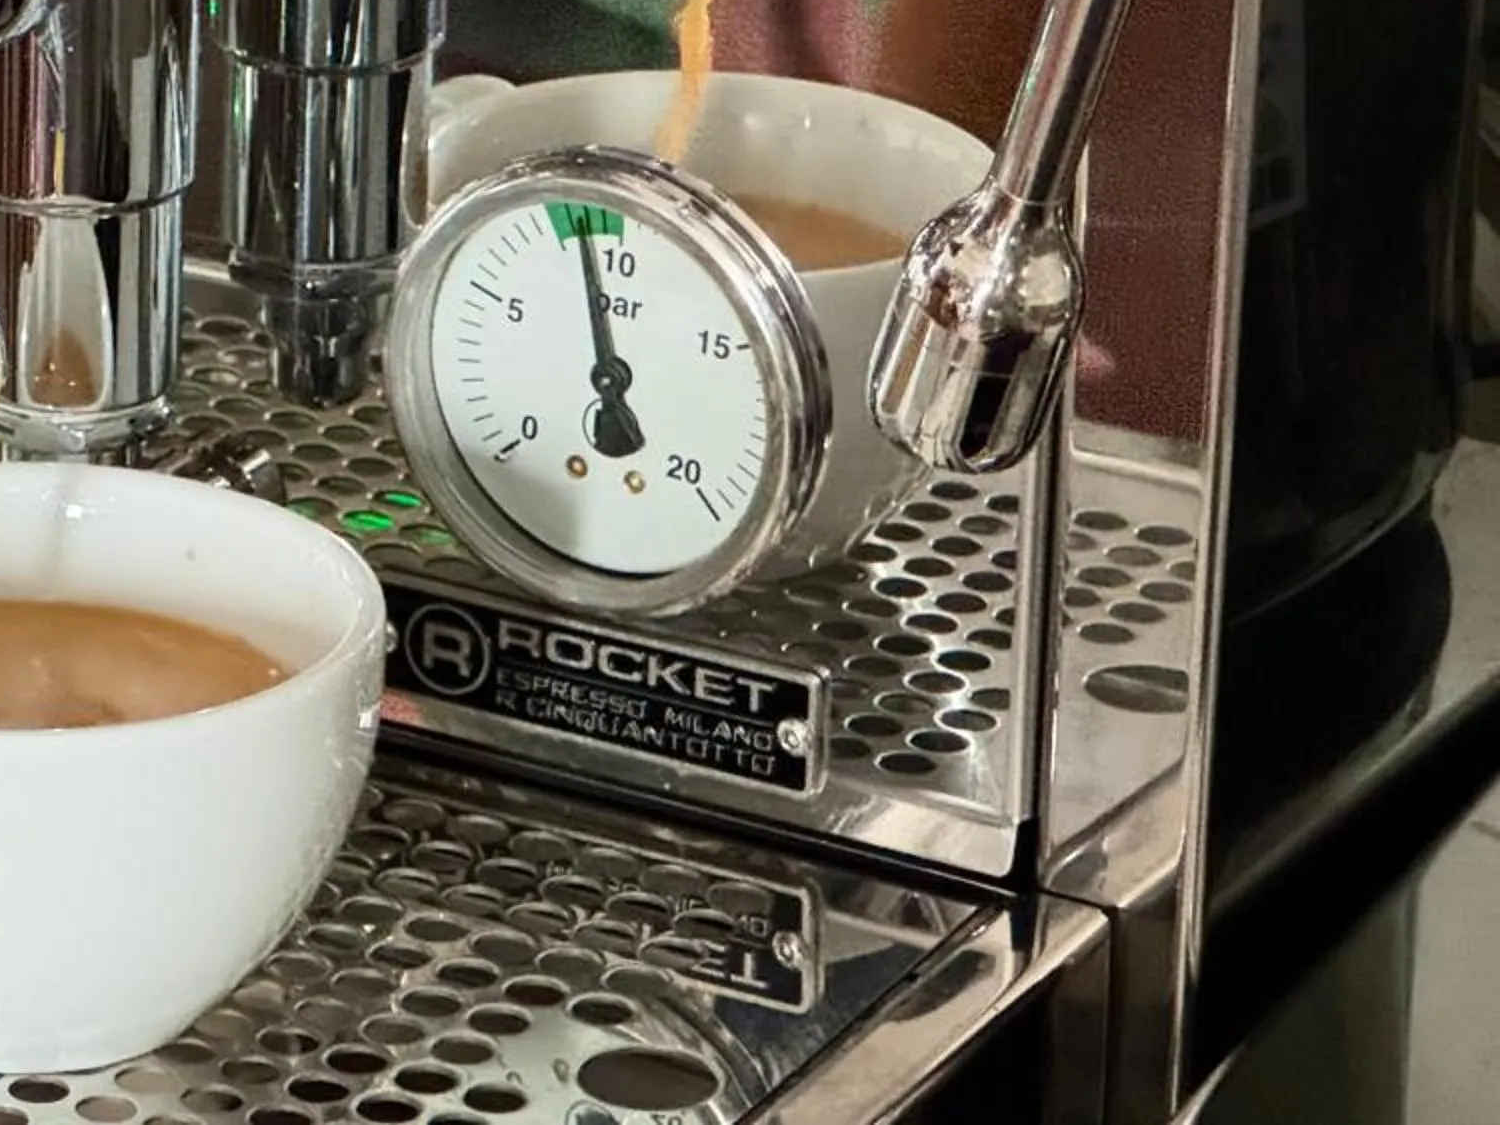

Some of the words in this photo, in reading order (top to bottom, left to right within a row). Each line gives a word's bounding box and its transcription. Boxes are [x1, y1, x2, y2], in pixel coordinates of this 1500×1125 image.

[602, 248, 636, 277] 10
[507, 299, 524, 323] 5
[697, 330, 731, 360] 15
[521, 415, 539, 440] 0
[667, 454, 702, 486] 20
[499, 620, 778, 713] ROCKET
[496, 669, 647, 720] ESPRESSO
[664, 706, 774, 752] MILANO
[525, 695, 777, 776] CINQUANTOTTO
